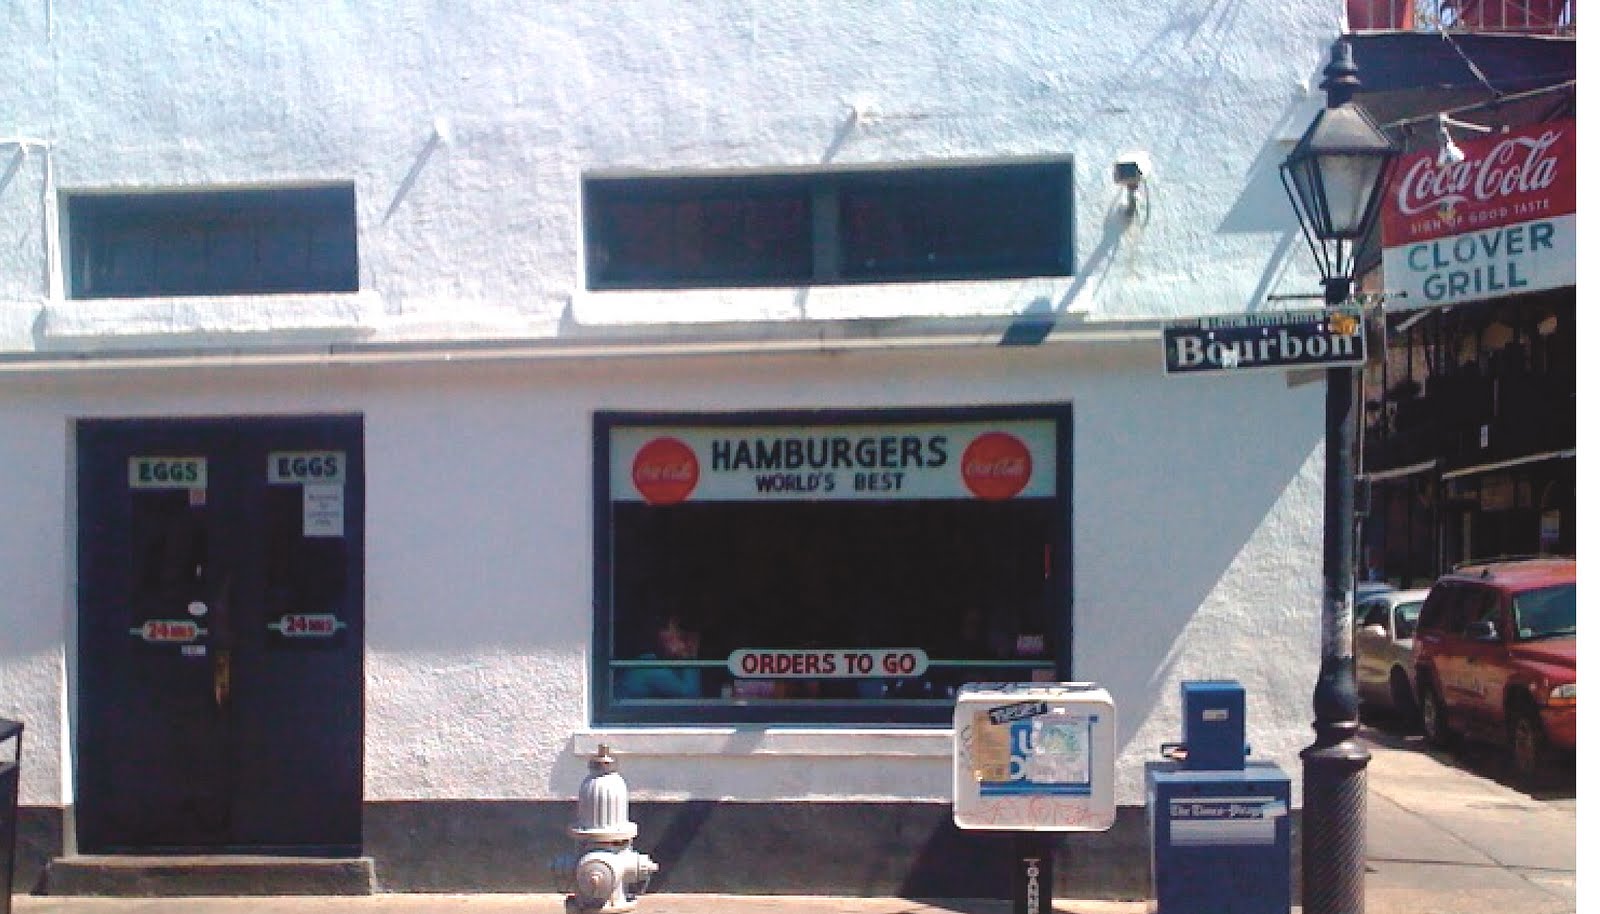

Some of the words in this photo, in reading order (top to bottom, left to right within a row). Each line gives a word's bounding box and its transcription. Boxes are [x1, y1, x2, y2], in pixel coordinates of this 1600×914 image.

[1398, 130, 1564, 215] Coca-Cola
[1469, 205, 1508, 223] GOOD
[1514, 199, 1550, 215] TASTE
[1407, 222, 1555, 272] CLOVER
[1422, 262, 1528, 301] GRILL
[1174, 329, 1355, 369] Bourbon
[711, 435, 948, 472] HAMBURGERS
[139, 462, 198, 481] EGGS
[277, 455, 338, 478] EGGS
[756, 472, 835, 493] WORLD'S
[854, 472, 904, 492] BEST
[147, 622, 168, 639] 24
[287, 616, 307, 632] 24
[742, 653, 836, 675] ORDERS
[844, 653, 873, 674] TO
[882, 653, 917, 674] GO
